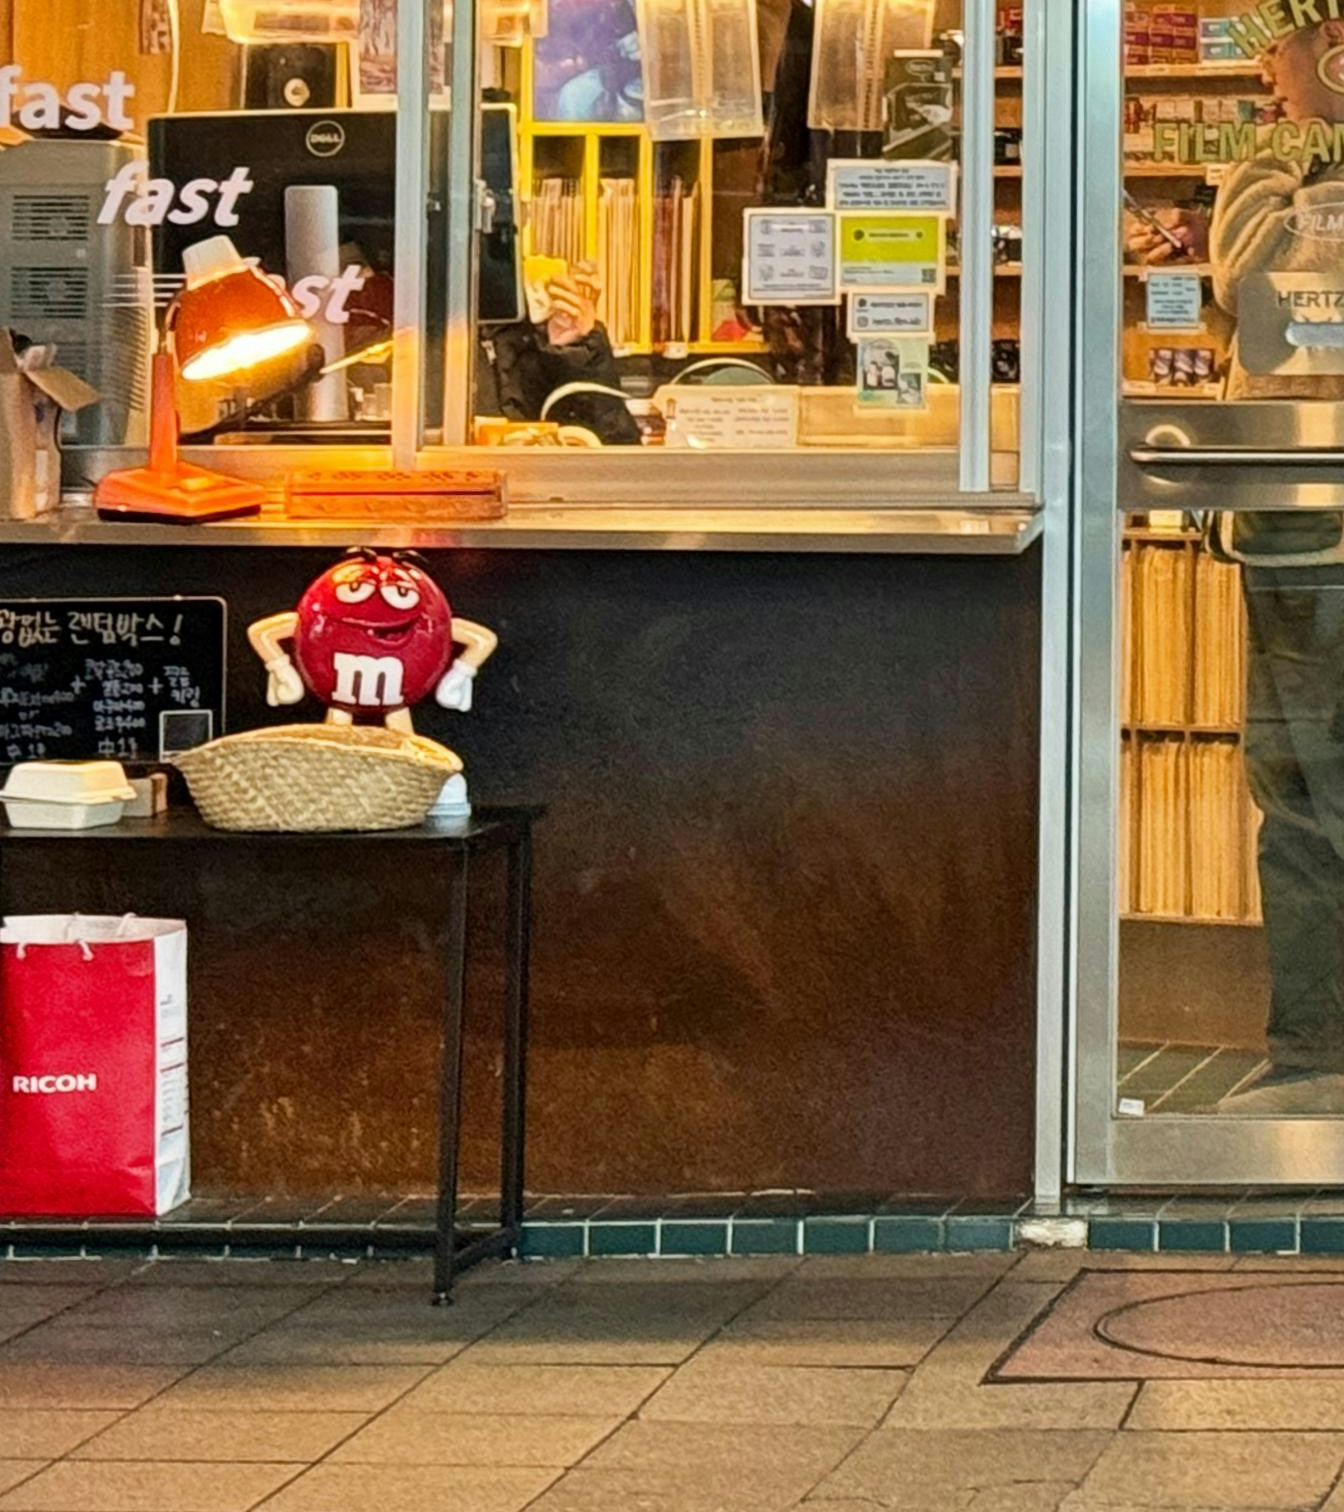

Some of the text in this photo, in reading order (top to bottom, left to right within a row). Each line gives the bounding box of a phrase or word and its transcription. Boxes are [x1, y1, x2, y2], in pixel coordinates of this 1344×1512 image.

[0, 65, 135, 131] fast
[1152, 122, 1257, 162] FILM
[97, 160, 253, 227] fast
[1298, 211, 1343, 232] FILM
[268, 260, 365, 324] st
[67, 611, 184, 647] 랜덤박스!
[332, 653, 403, 706] m
[13, 1073, 97, 1093] RICOH
